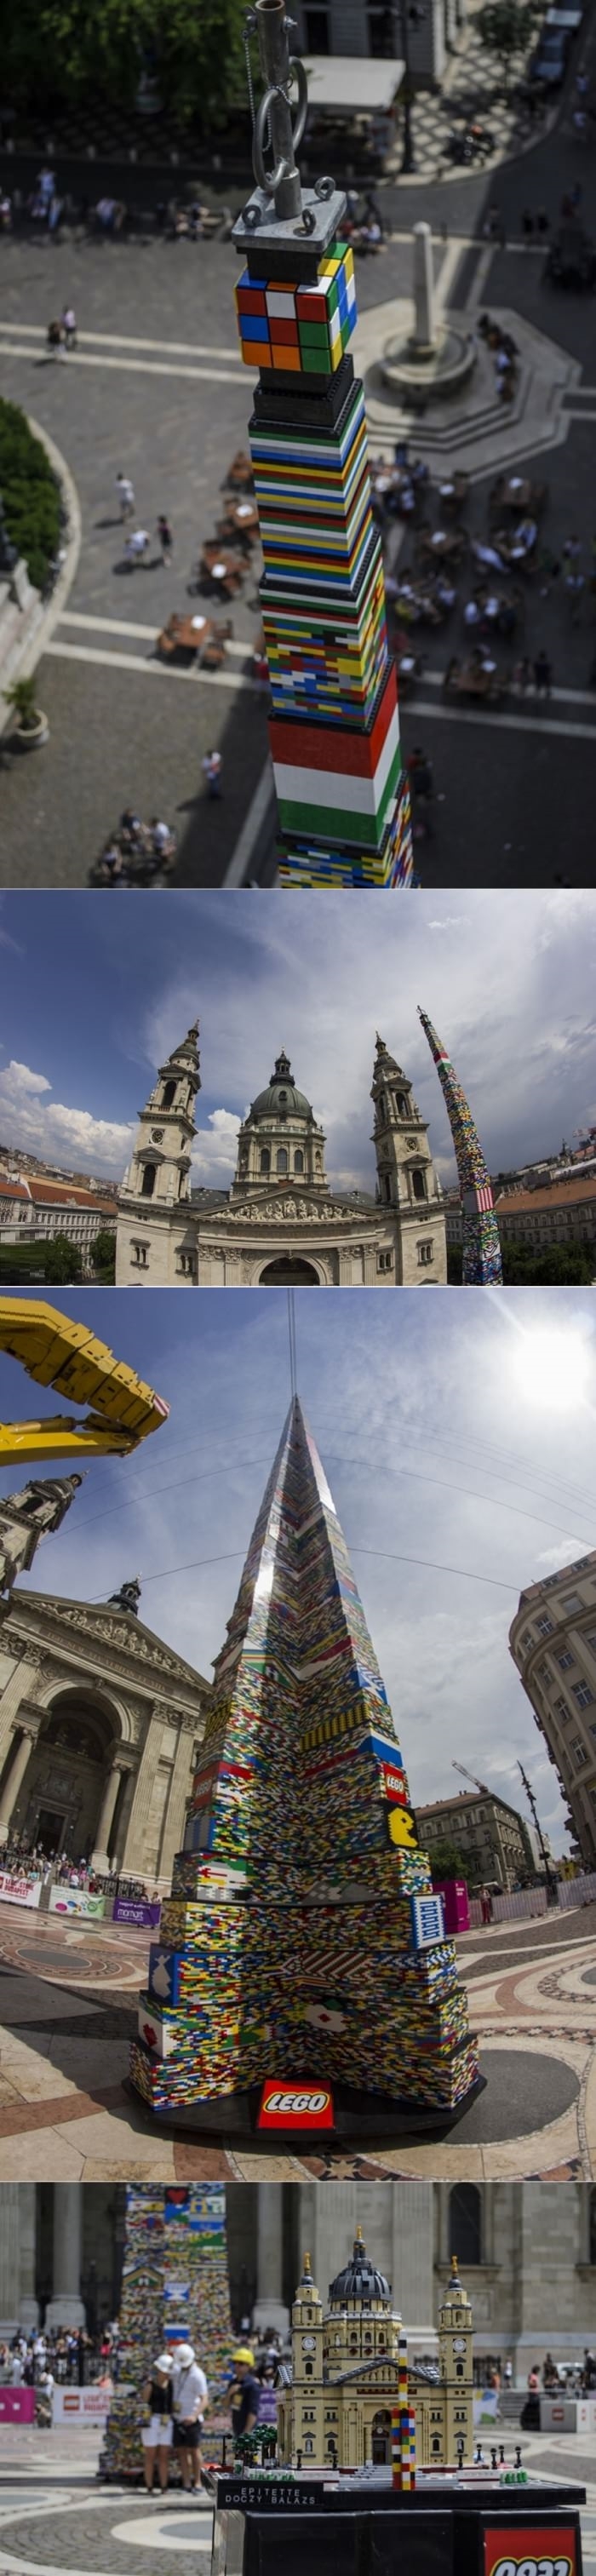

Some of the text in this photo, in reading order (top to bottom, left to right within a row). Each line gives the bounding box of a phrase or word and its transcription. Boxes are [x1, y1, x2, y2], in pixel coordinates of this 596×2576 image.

[387, 1776, 404, 1793] LEGO
[266, 2093, 328, 2112] LEGO
[241, 2487, 301, 2497] EPITETTE
